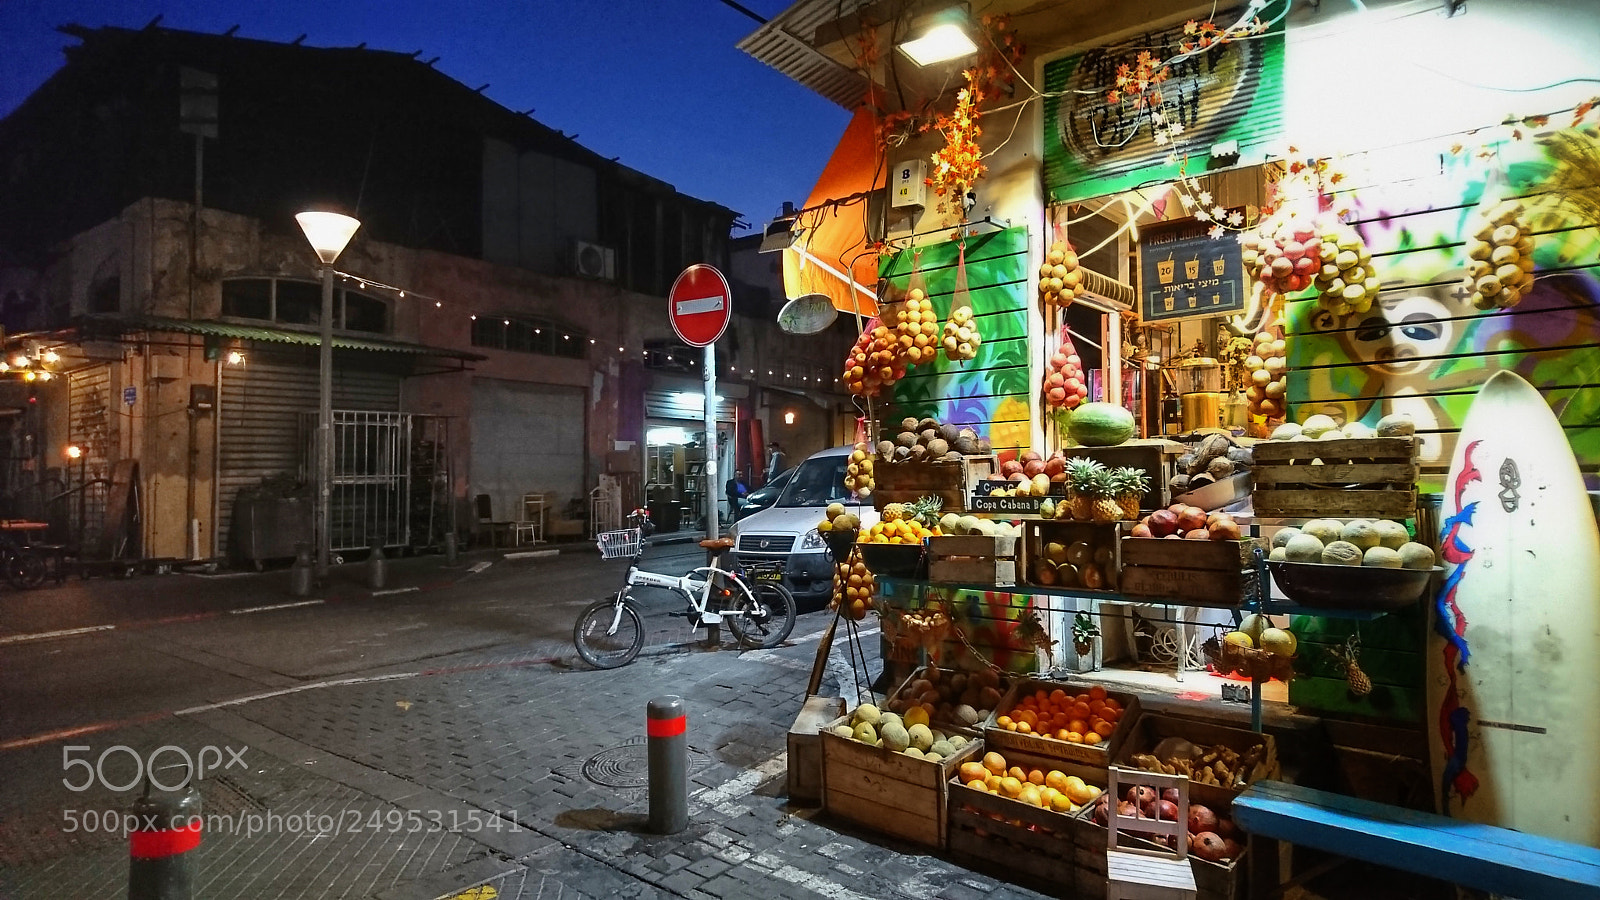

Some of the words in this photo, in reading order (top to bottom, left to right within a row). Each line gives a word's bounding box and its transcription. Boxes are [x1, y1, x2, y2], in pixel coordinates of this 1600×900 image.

[1149, 232, 1177, 246] FRESH
[1180, 228, 1206, 240] JUICE
[1163, 281, 1195, 293] בריאות
[1198, 278, 1219, 288] מיצי
[976, 499, 997, 511] Copa
[1000, 499, 1031, 510] Cabana
